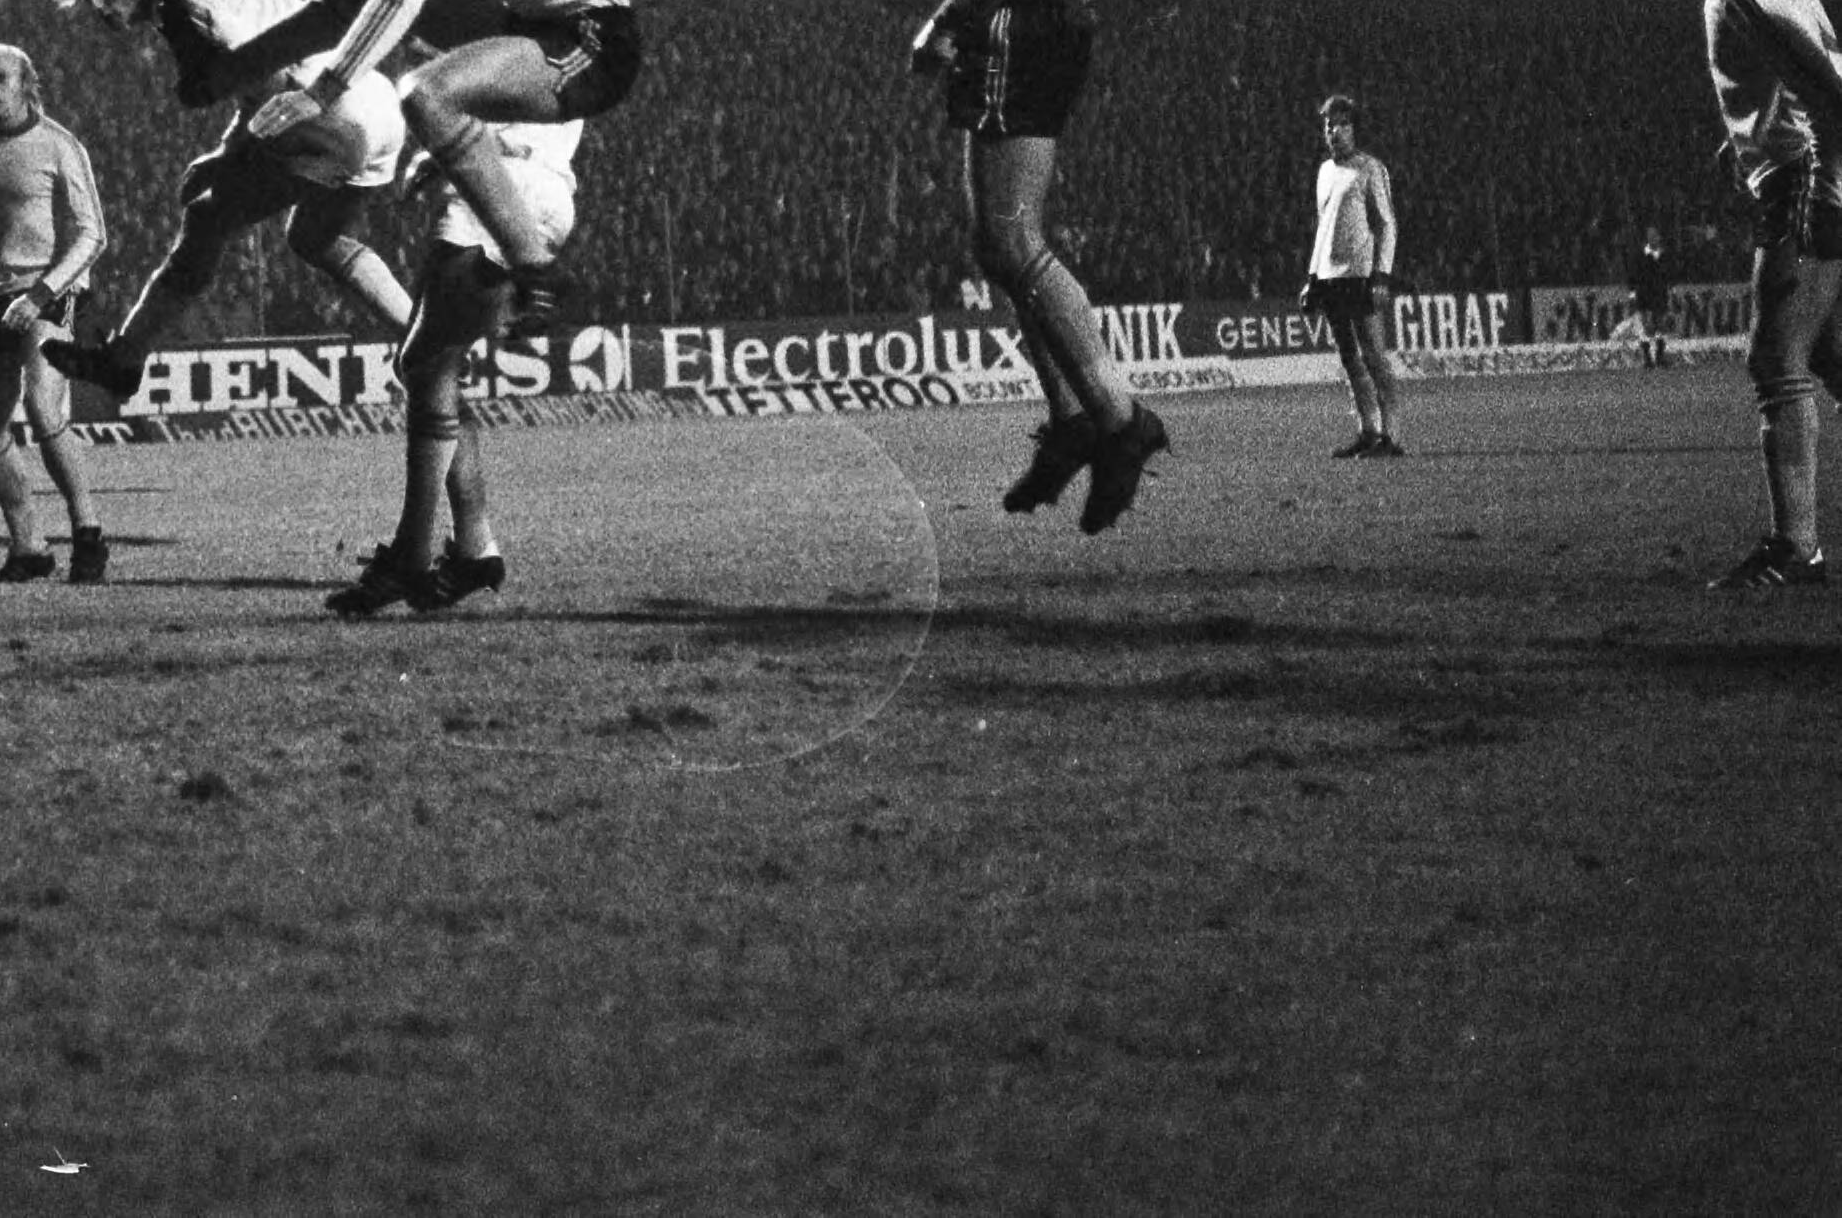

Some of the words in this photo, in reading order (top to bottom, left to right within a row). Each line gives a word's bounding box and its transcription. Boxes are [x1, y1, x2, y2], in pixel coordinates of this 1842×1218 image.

[660, 315, 1038, 388] Electrolux
[1393, 293, 1509, 353] GIRAF
[706, 374, 959, 415] TETTEROO
